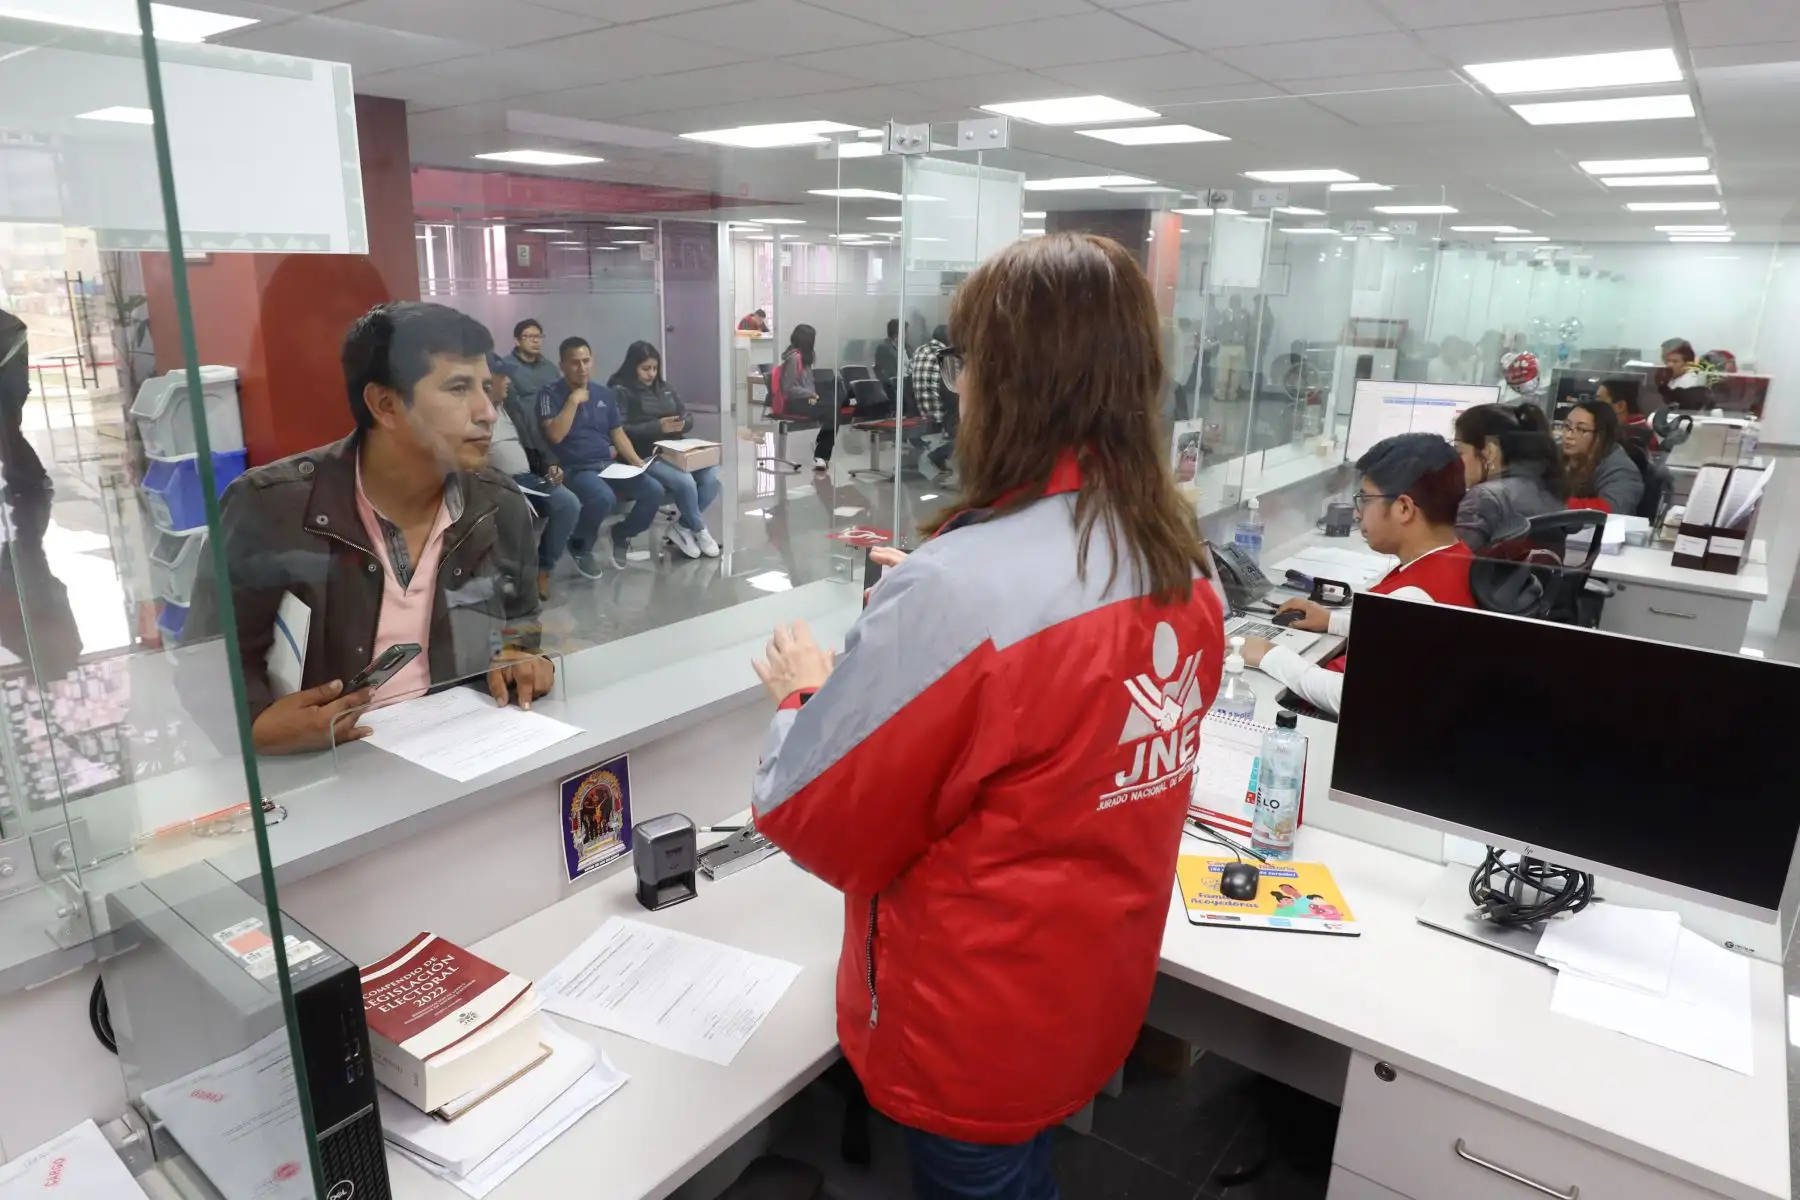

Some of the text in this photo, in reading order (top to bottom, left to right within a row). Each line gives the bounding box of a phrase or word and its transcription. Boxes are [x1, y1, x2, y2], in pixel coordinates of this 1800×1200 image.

[1115, 716, 1198, 787] JNE
[1096, 776, 1179, 812] JURADO NACIONAL DE
[362, 967, 423, 1000] COMPENDIO
[424, 956, 438, 968] DE
[364, 954, 456, 1010] LEGISLACIÓN
[379, 965, 460, 1014] ELECTORAL
[413, 986, 448, 1008] 2022
